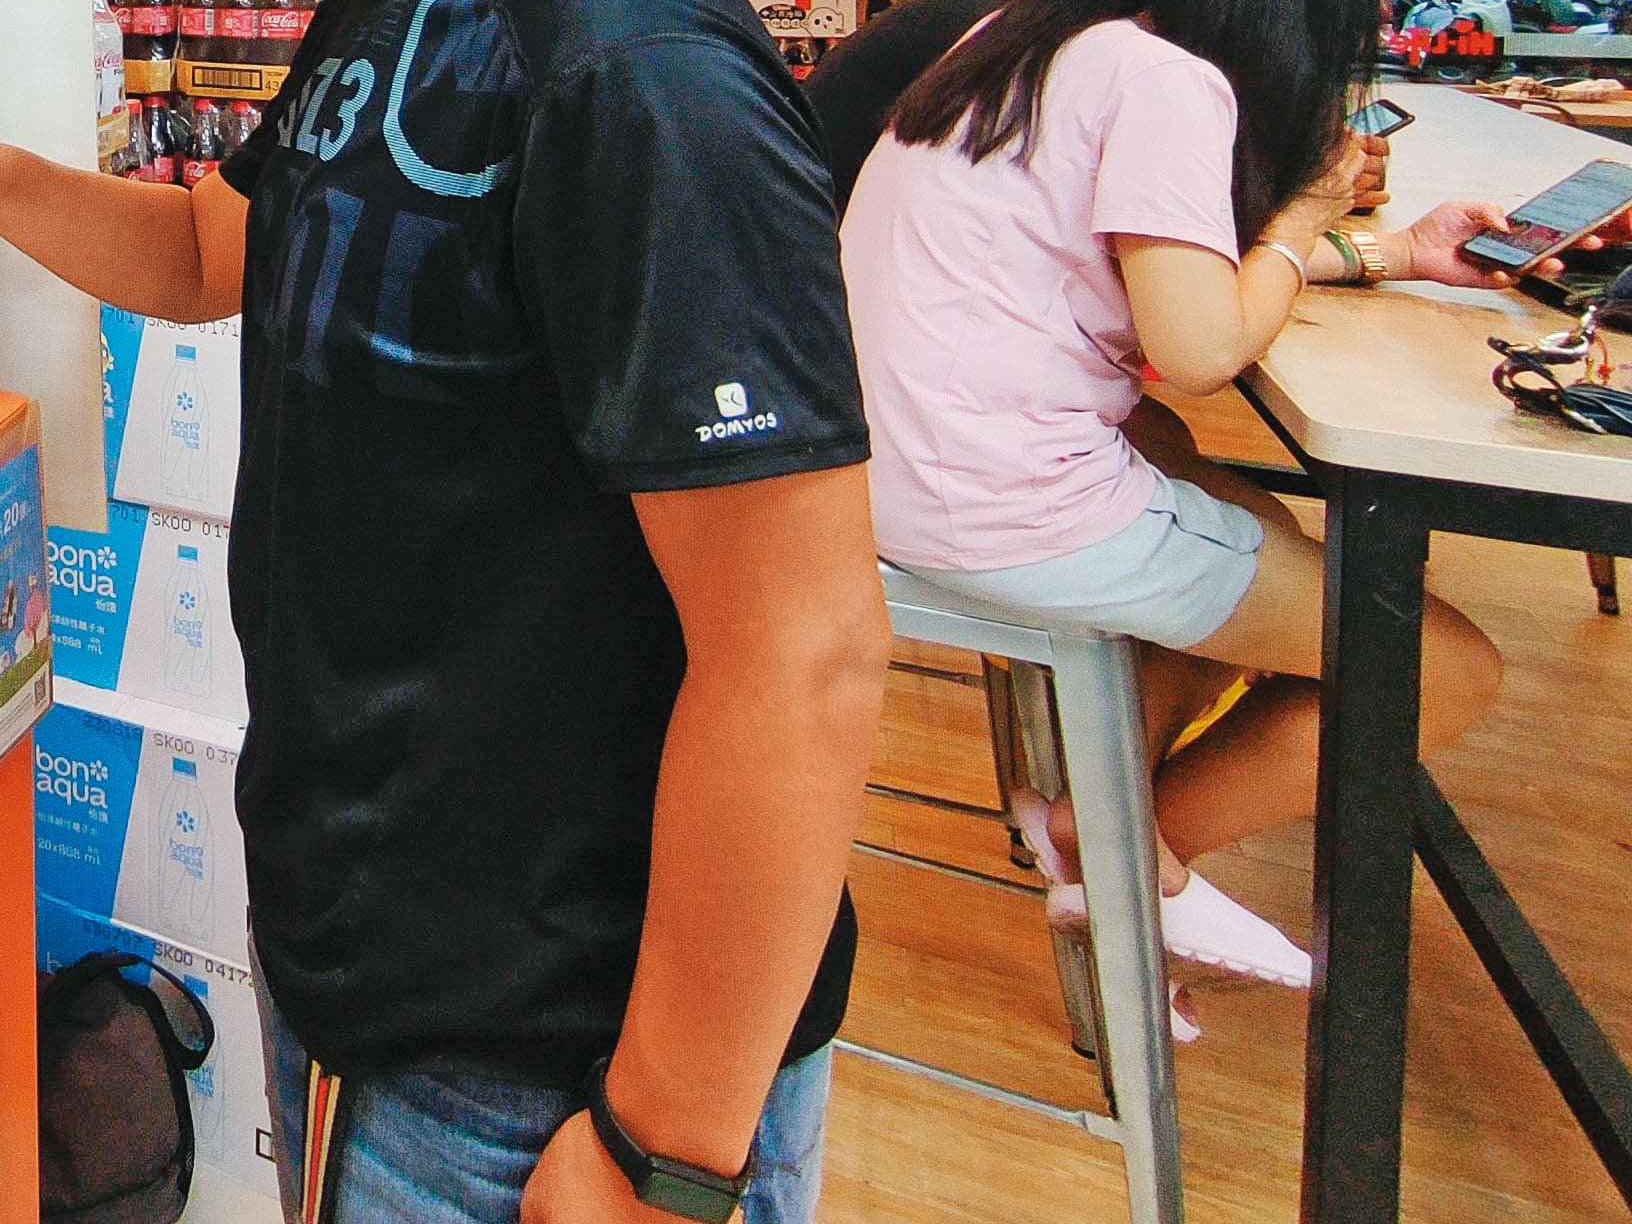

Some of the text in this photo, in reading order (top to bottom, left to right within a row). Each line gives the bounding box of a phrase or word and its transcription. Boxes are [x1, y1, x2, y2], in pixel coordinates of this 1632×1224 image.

[695, 412, 777, 442] DOMYOS
[48, 563, 117, 598] aqua
[35, 744, 89, 782] bon
[36, 772, 108, 809] aqua
